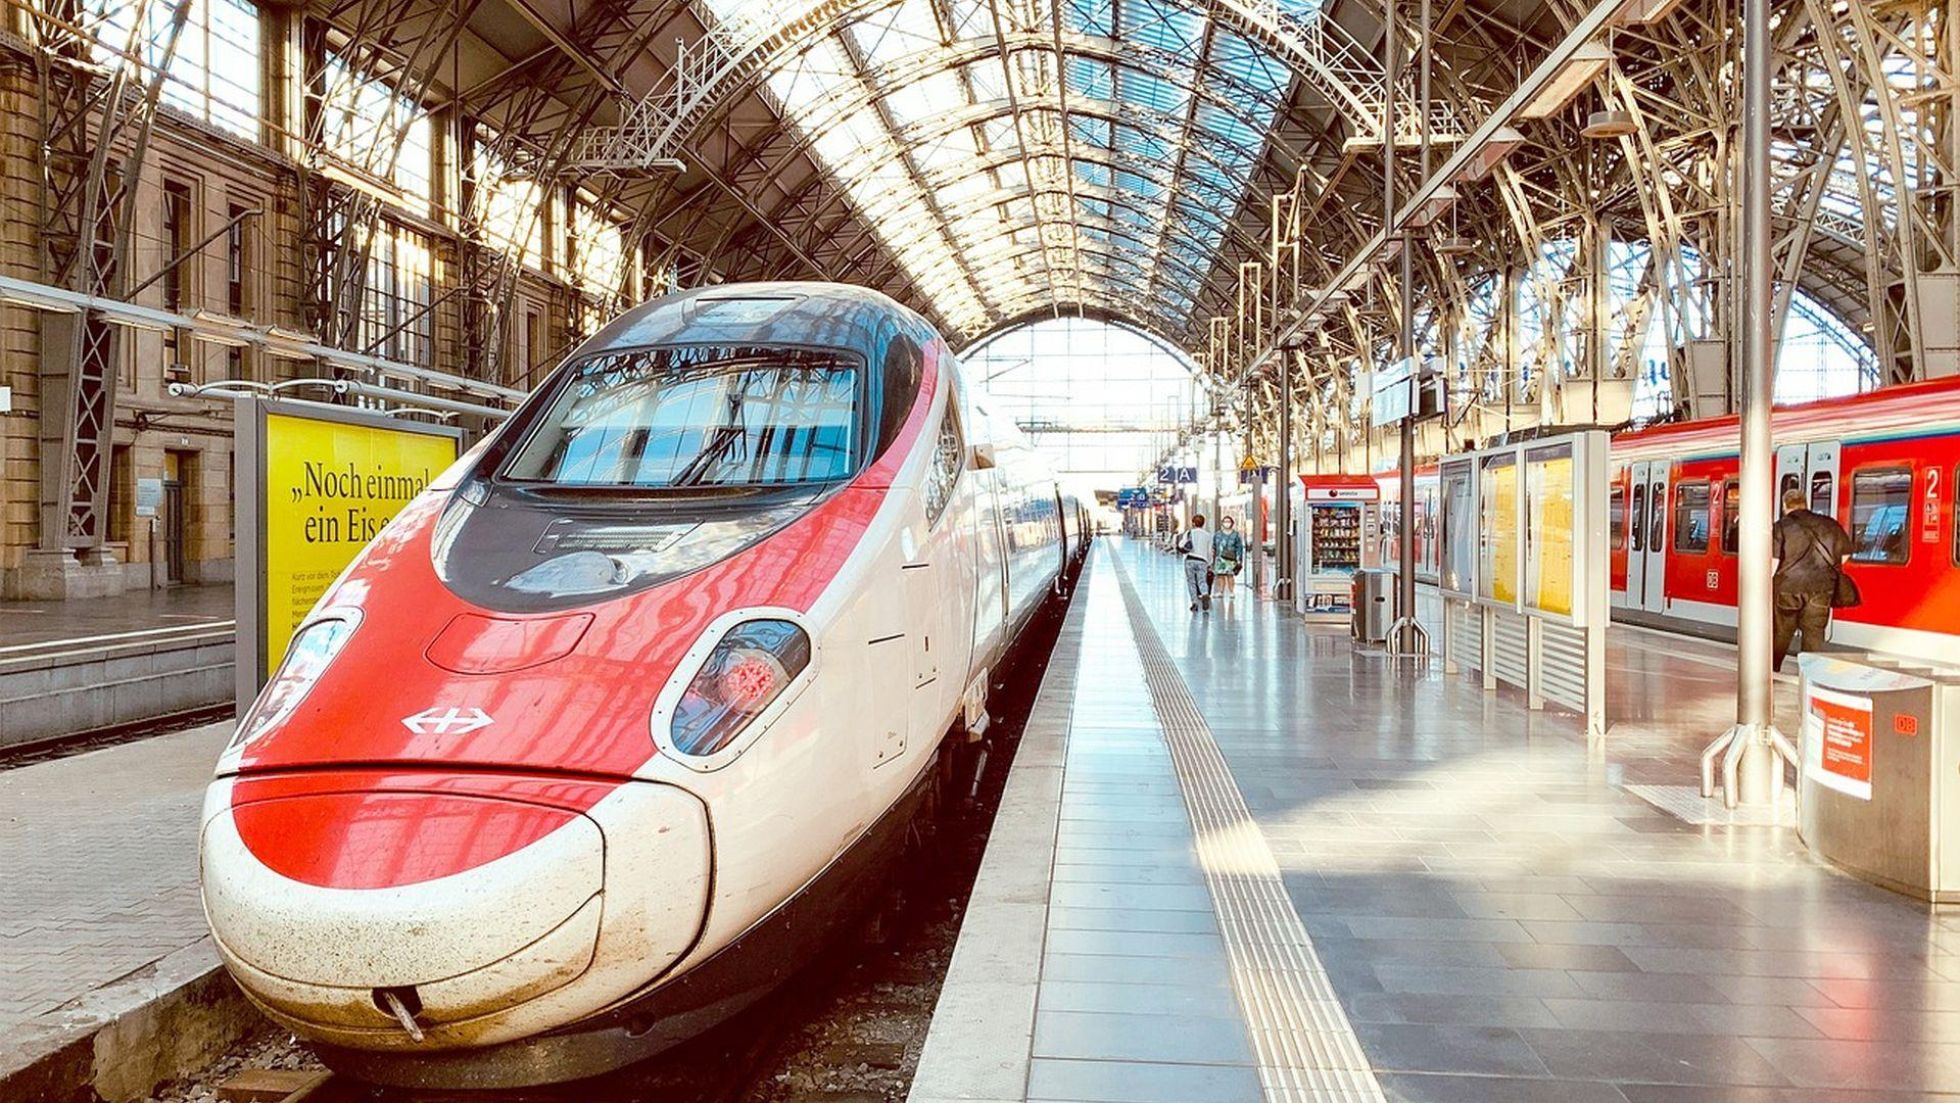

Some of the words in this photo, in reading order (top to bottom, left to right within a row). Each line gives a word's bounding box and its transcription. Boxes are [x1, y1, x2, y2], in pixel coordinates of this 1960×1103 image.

[1159, 467, 1170, 481] 2
[1179, 468, 1191, 481] A
[1926, 468, 1939, 498] 2
[1712, 482, 1721, 505] 2
[304, 505, 339, 543] ein
[1896, 716, 1916, 734] DB
